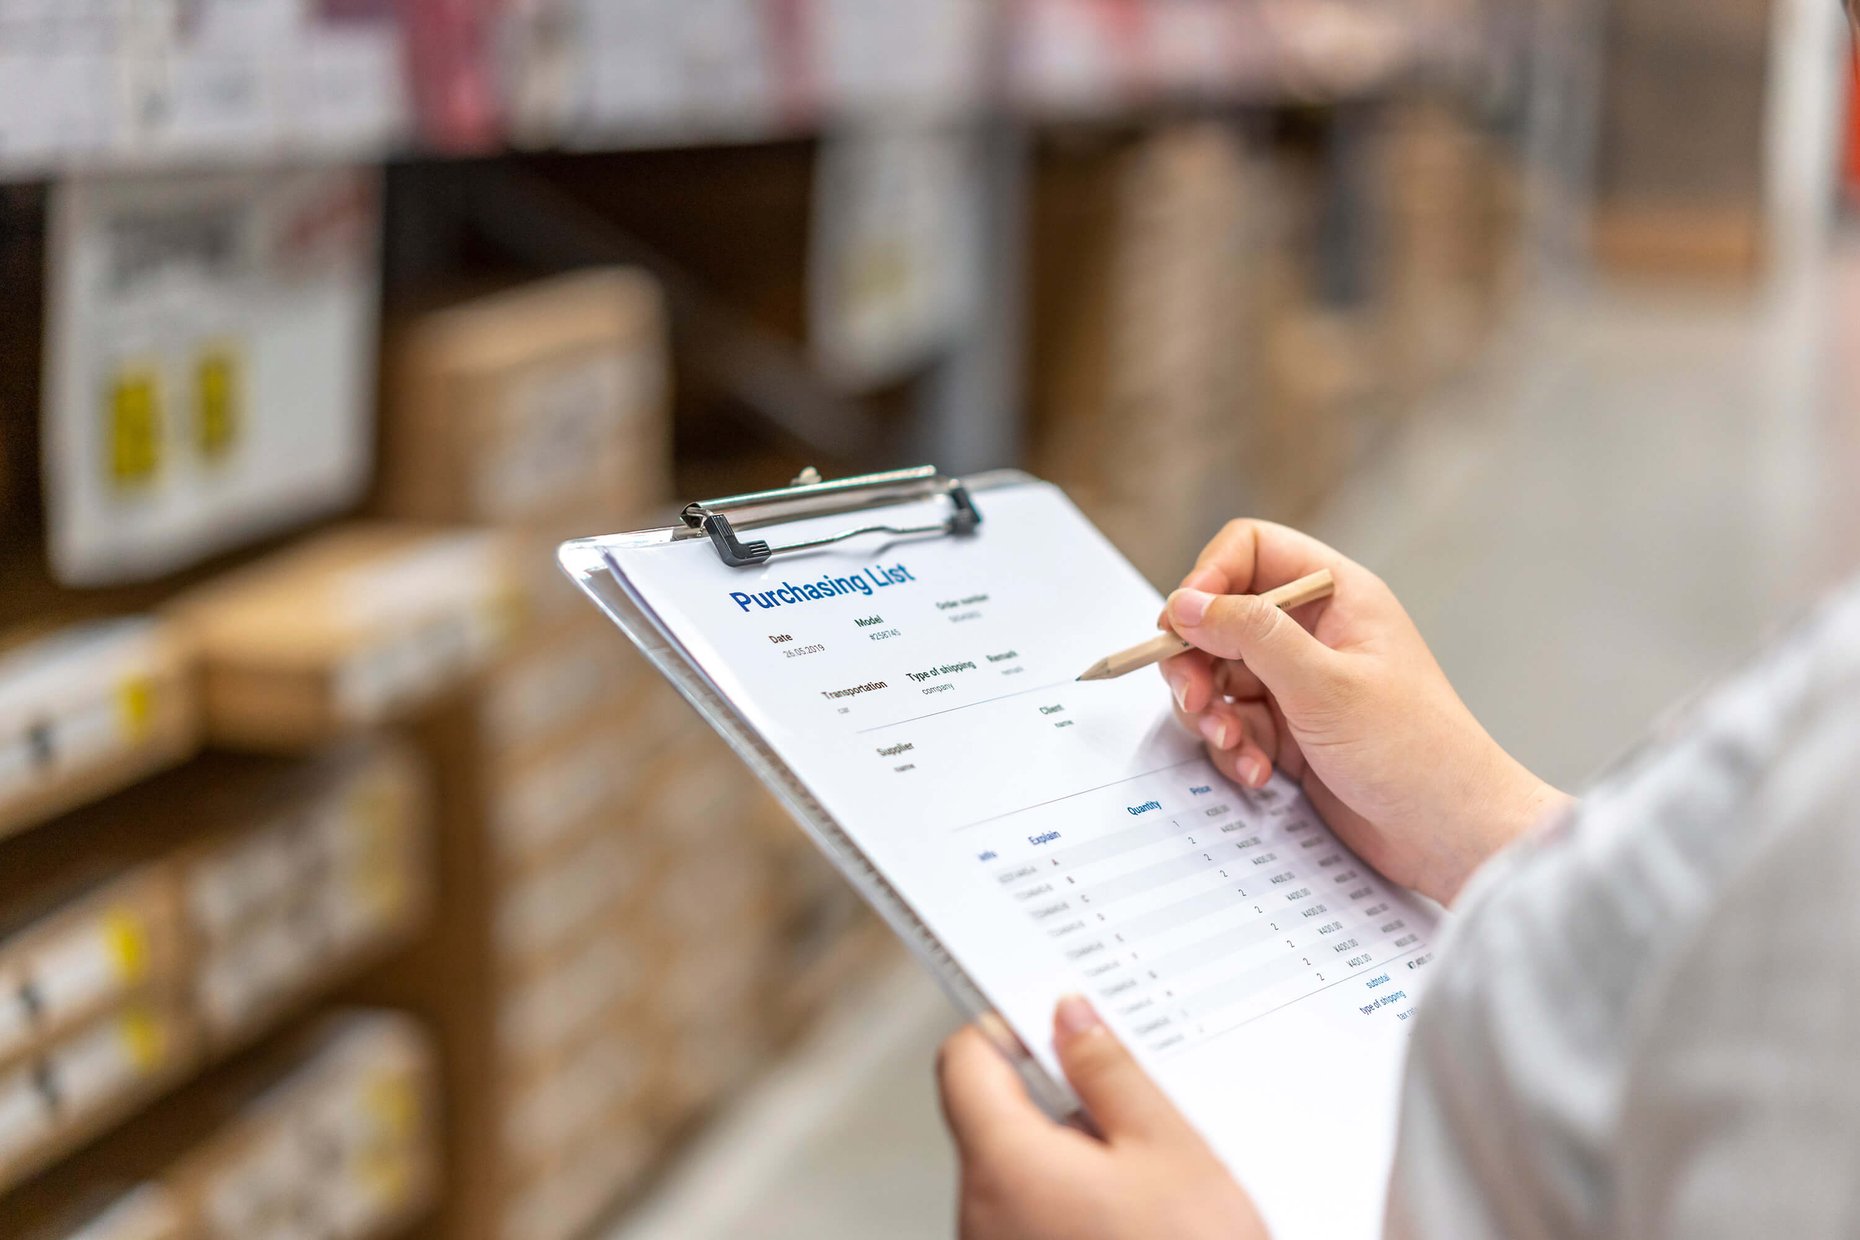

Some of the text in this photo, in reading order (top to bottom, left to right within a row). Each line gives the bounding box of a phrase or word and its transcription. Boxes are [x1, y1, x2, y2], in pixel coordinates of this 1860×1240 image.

[729, 563, 916, 612] Purchasing List
[854, 615, 884, 628] Model
[768, 632, 793, 644] Date
[783, 643, 825, 658] 26.05.2019
[906, 660, 977, 683] Type of shipping
[821, 680, 888, 700] Transportation
[922, 682, 955, 696] company
[876, 741, 914, 758] Supplier
[1127, 799, 1162, 817] Quantity
[1173, 820, 1181, 828] 1
[1028, 830, 1062, 846] Explain
[1188, 836, 1196, 845] 2
[1204, 853, 1212, 861] 2
[1220, 869, 1228, 878] 2
[1238, 888, 1247, 897] 2
[1254, 905, 1263, 914] 2
[1270, 922, 1279, 931] 2
[1286, 940, 1295, 948] 2
[1302, 957, 1311, 966] 2
[1316, 972, 1325, 981] 2
[1366, 972, 1391, 988] subtotal
[1360, 1003, 1376, 1016] type
[1380, 990, 1407, 1006] shipping
